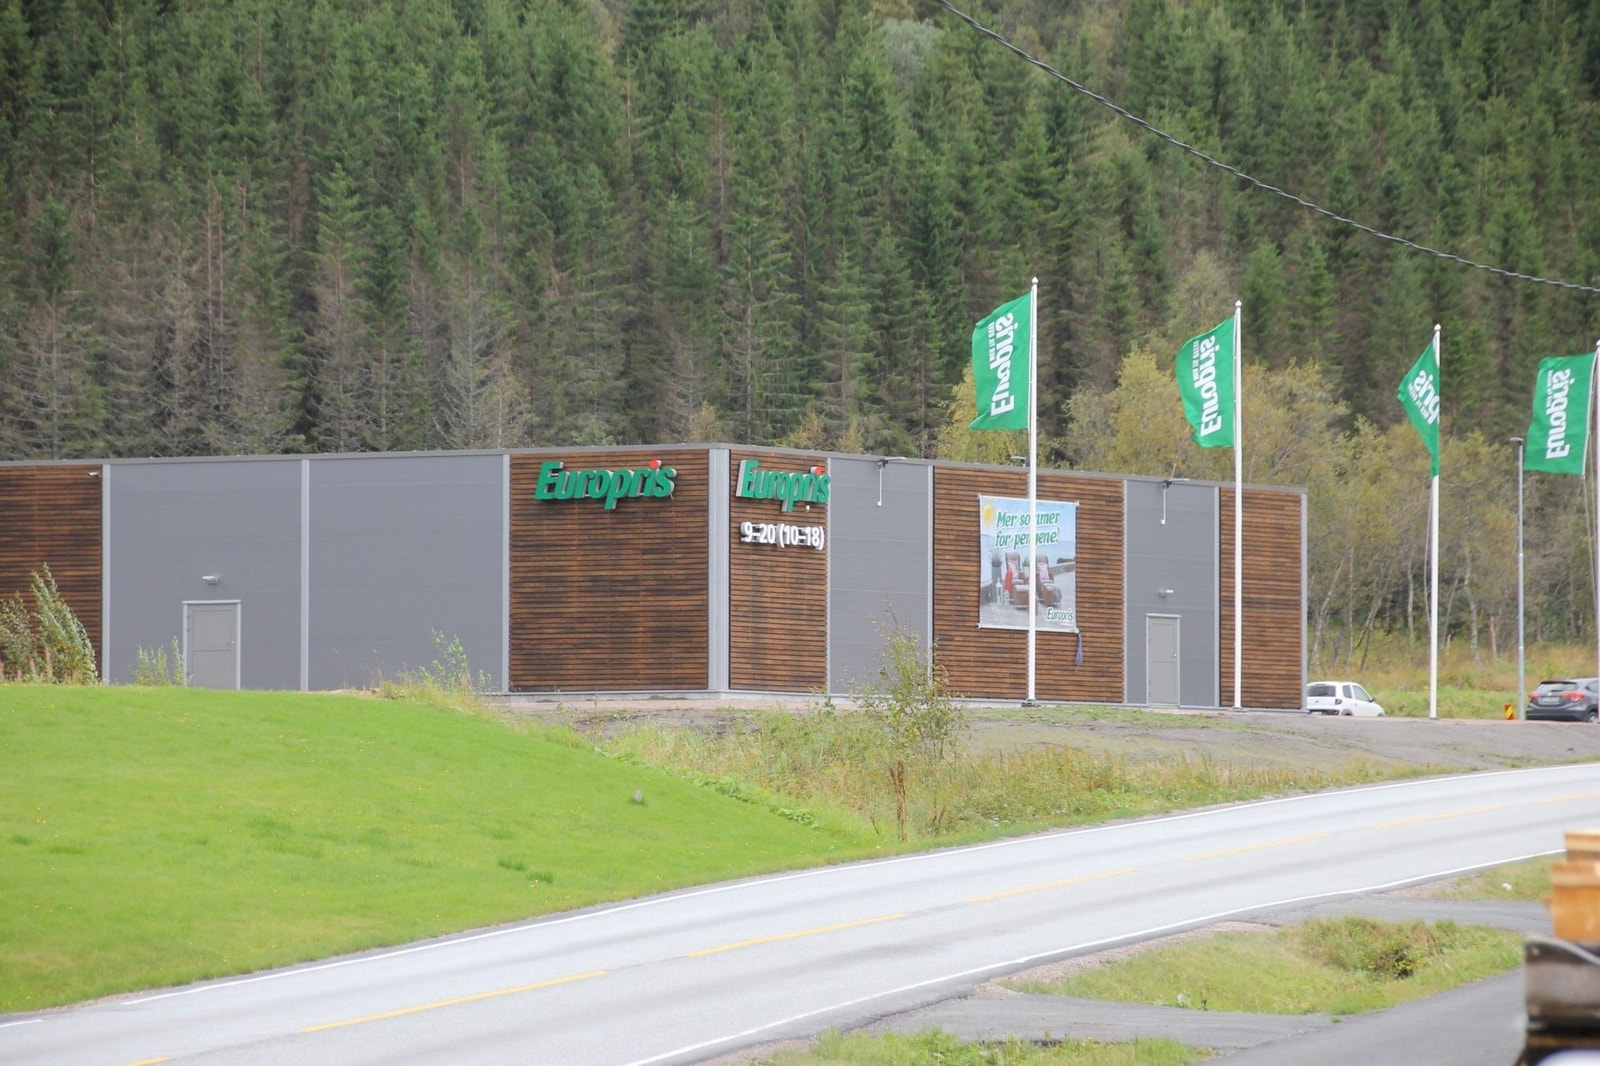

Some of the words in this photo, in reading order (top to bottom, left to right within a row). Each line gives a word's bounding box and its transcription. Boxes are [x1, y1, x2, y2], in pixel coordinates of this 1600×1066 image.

[534, 459, 677, 510] Europris
[736, 459, 831, 512] Europris
[996, 511, 1018, 528] Mer
[741, 521, 776, 543] 9-20
[779, 523, 825, 550] (10-18)
[995, 530, 1011, 547] for
